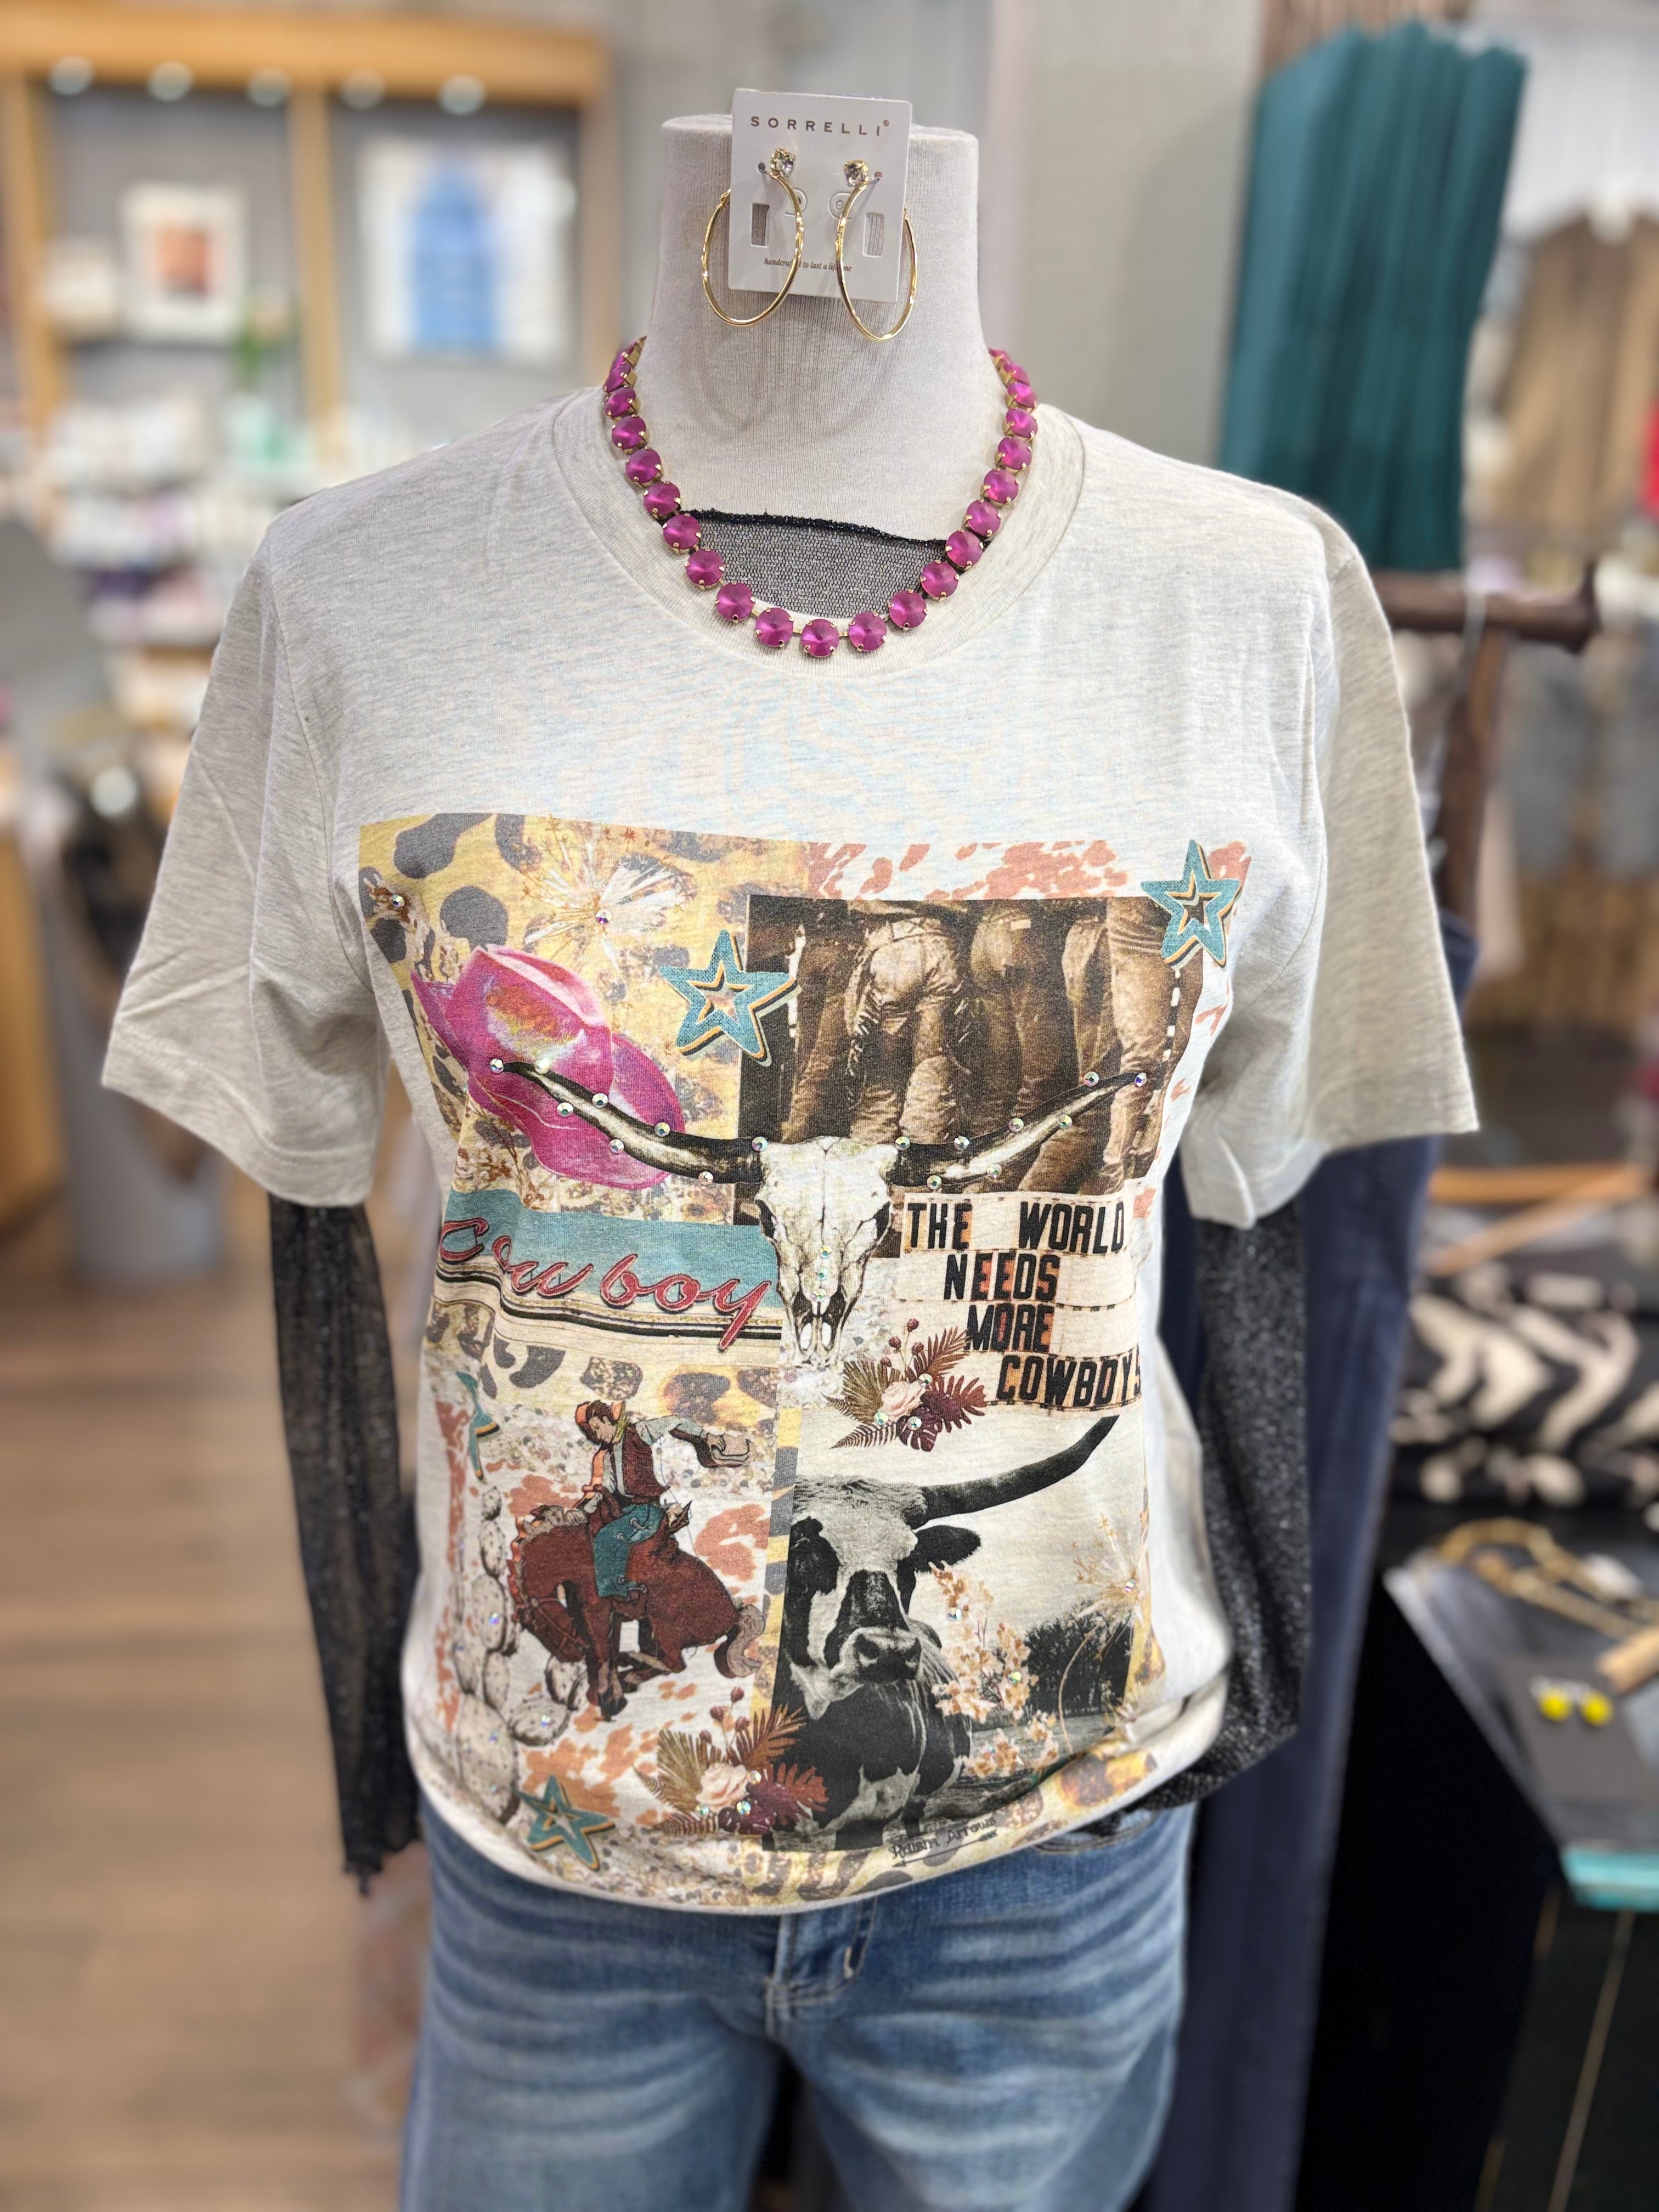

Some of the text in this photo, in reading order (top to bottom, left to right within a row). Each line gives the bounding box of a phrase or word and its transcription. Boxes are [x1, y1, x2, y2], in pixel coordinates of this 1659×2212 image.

[764, 257, 802, 268] handcraf
[810, 261, 822, 269] last
[828, 262, 852, 272] lifme
[908, 1201, 1124, 1254] THE WORLD
[944, 1252, 1060, 1302] NEEDS
[964, 1304, 1055, 1352] MORE
[944, 1817, 996, 1847] Arrows
